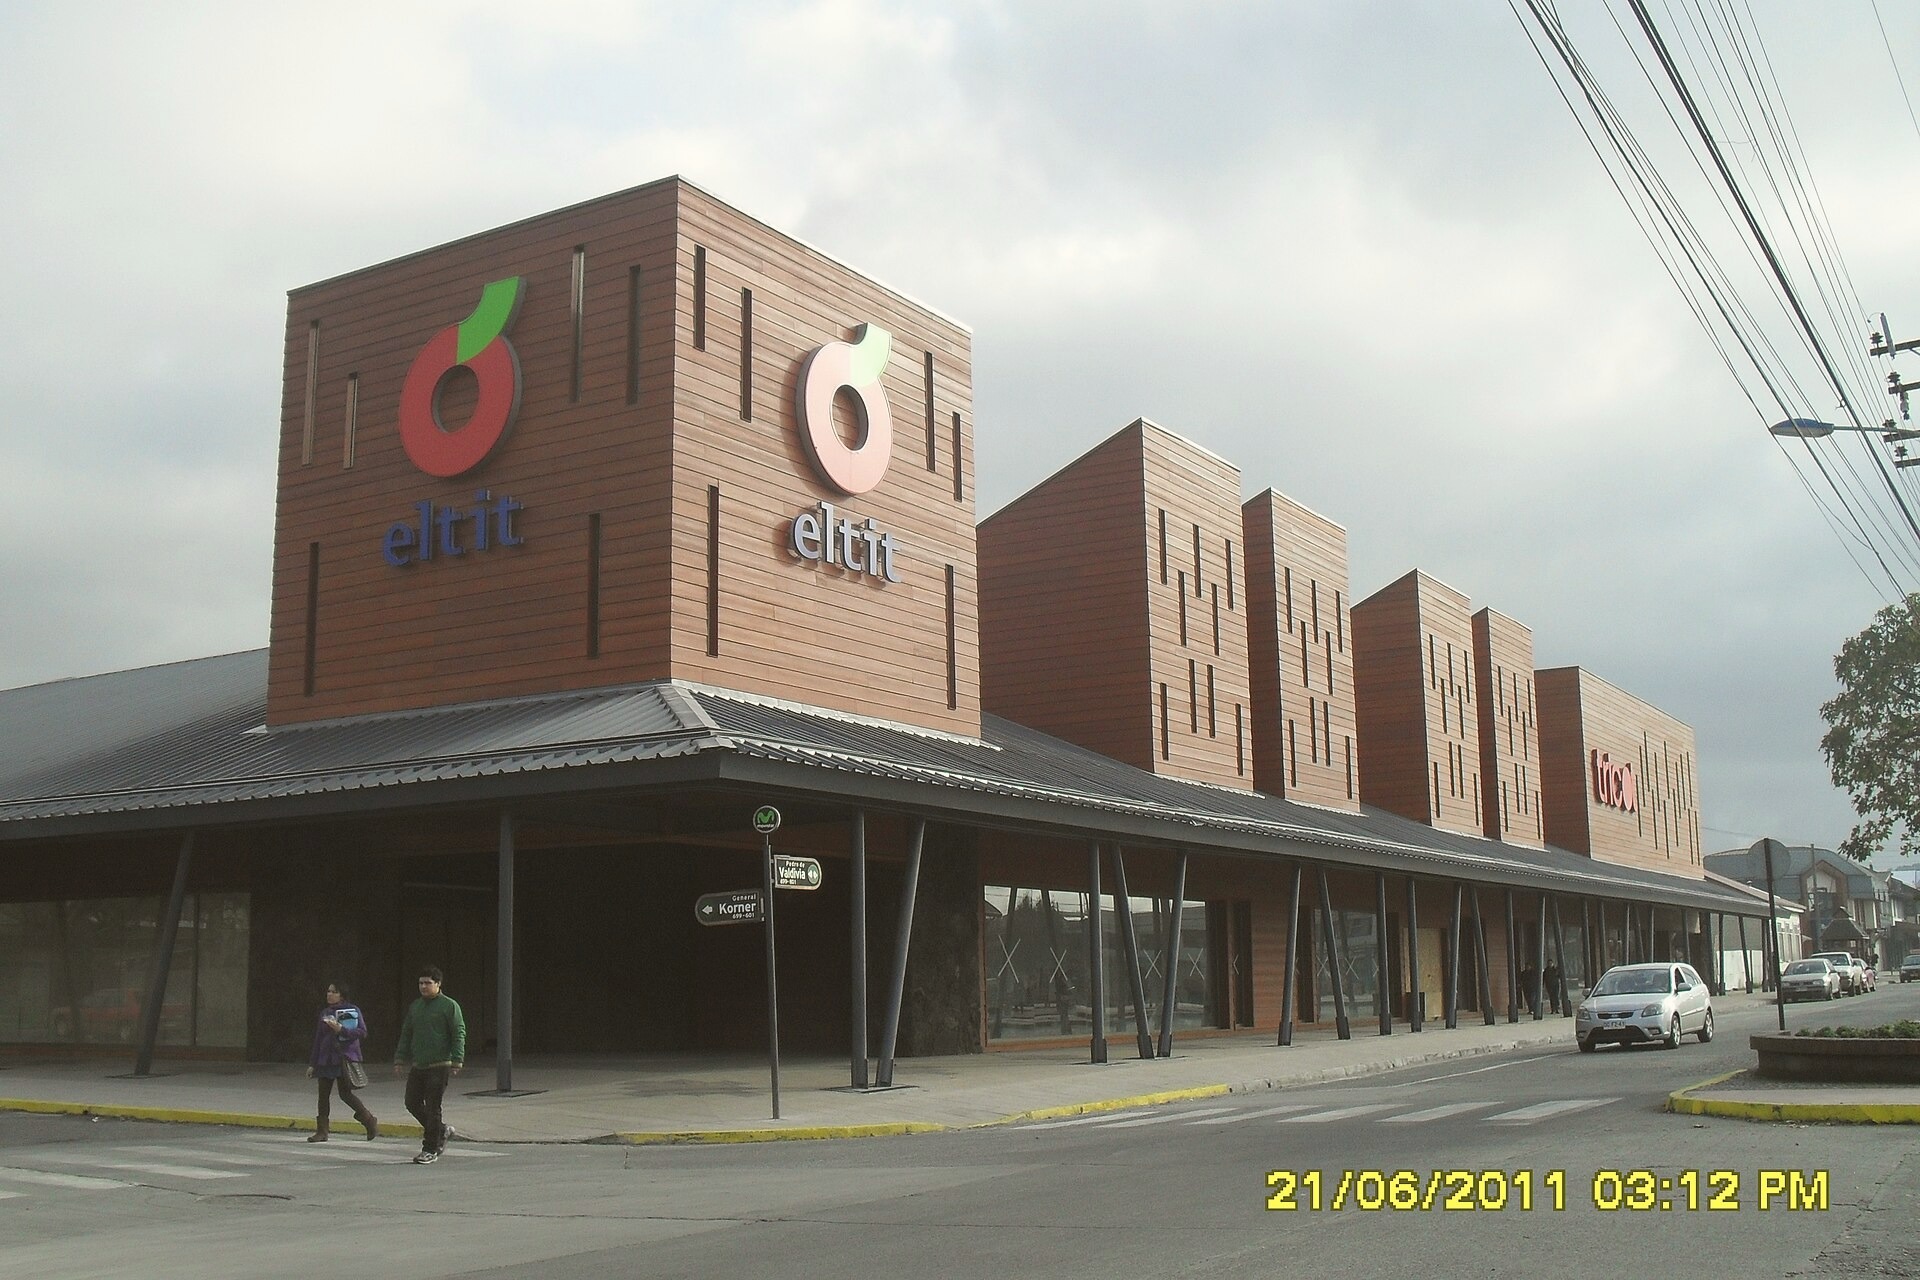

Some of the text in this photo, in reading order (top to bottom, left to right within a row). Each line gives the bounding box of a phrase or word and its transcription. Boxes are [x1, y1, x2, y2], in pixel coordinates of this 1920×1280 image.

[382, 488, 524, 567] eltit
[791, 501, 902, 583] eltit
[778, 866, 806, 880] Valdivia
[731, 893, 757, 901] General
[719, 902, 757, 914] Korner
